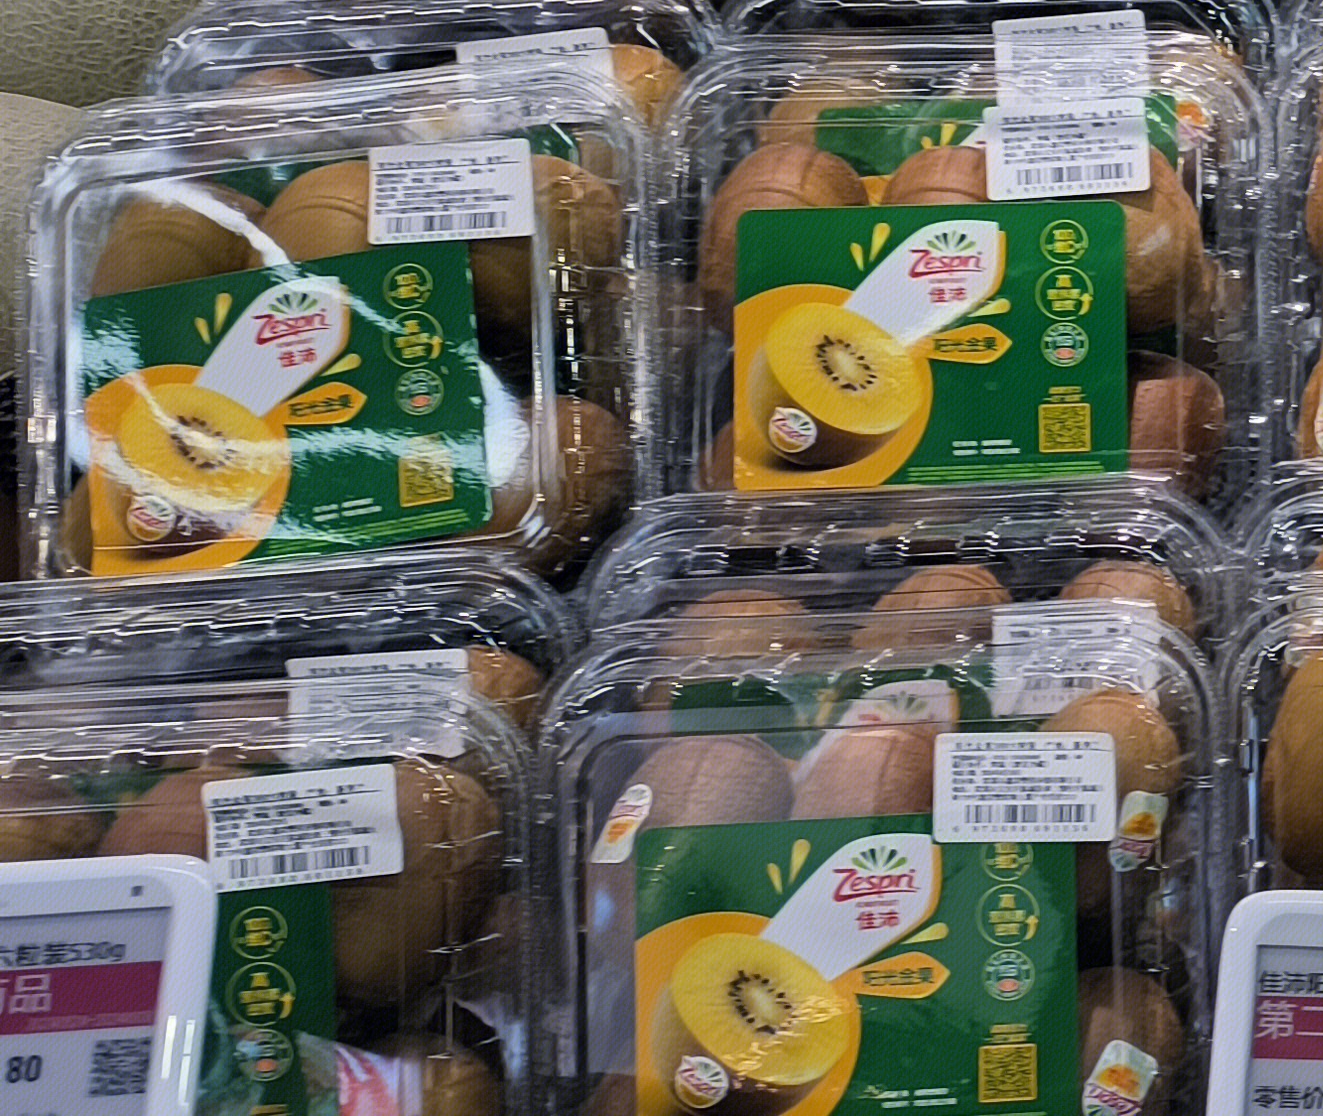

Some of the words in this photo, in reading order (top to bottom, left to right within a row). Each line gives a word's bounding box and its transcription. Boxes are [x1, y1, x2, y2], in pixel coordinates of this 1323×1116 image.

[908, 248, 987, 277] Zespri
[928, 287, 968, 305] 佳沛
[253, 308, 331, 345] Zespri
[277, 347, 319, 369] 佳沛
[831, 867, 919, 903] Zespri
[856, 910, 901, 931] 佳沛
[0, 973, 53, 1015] 品
[6, 1055, 43, 1083] 80
